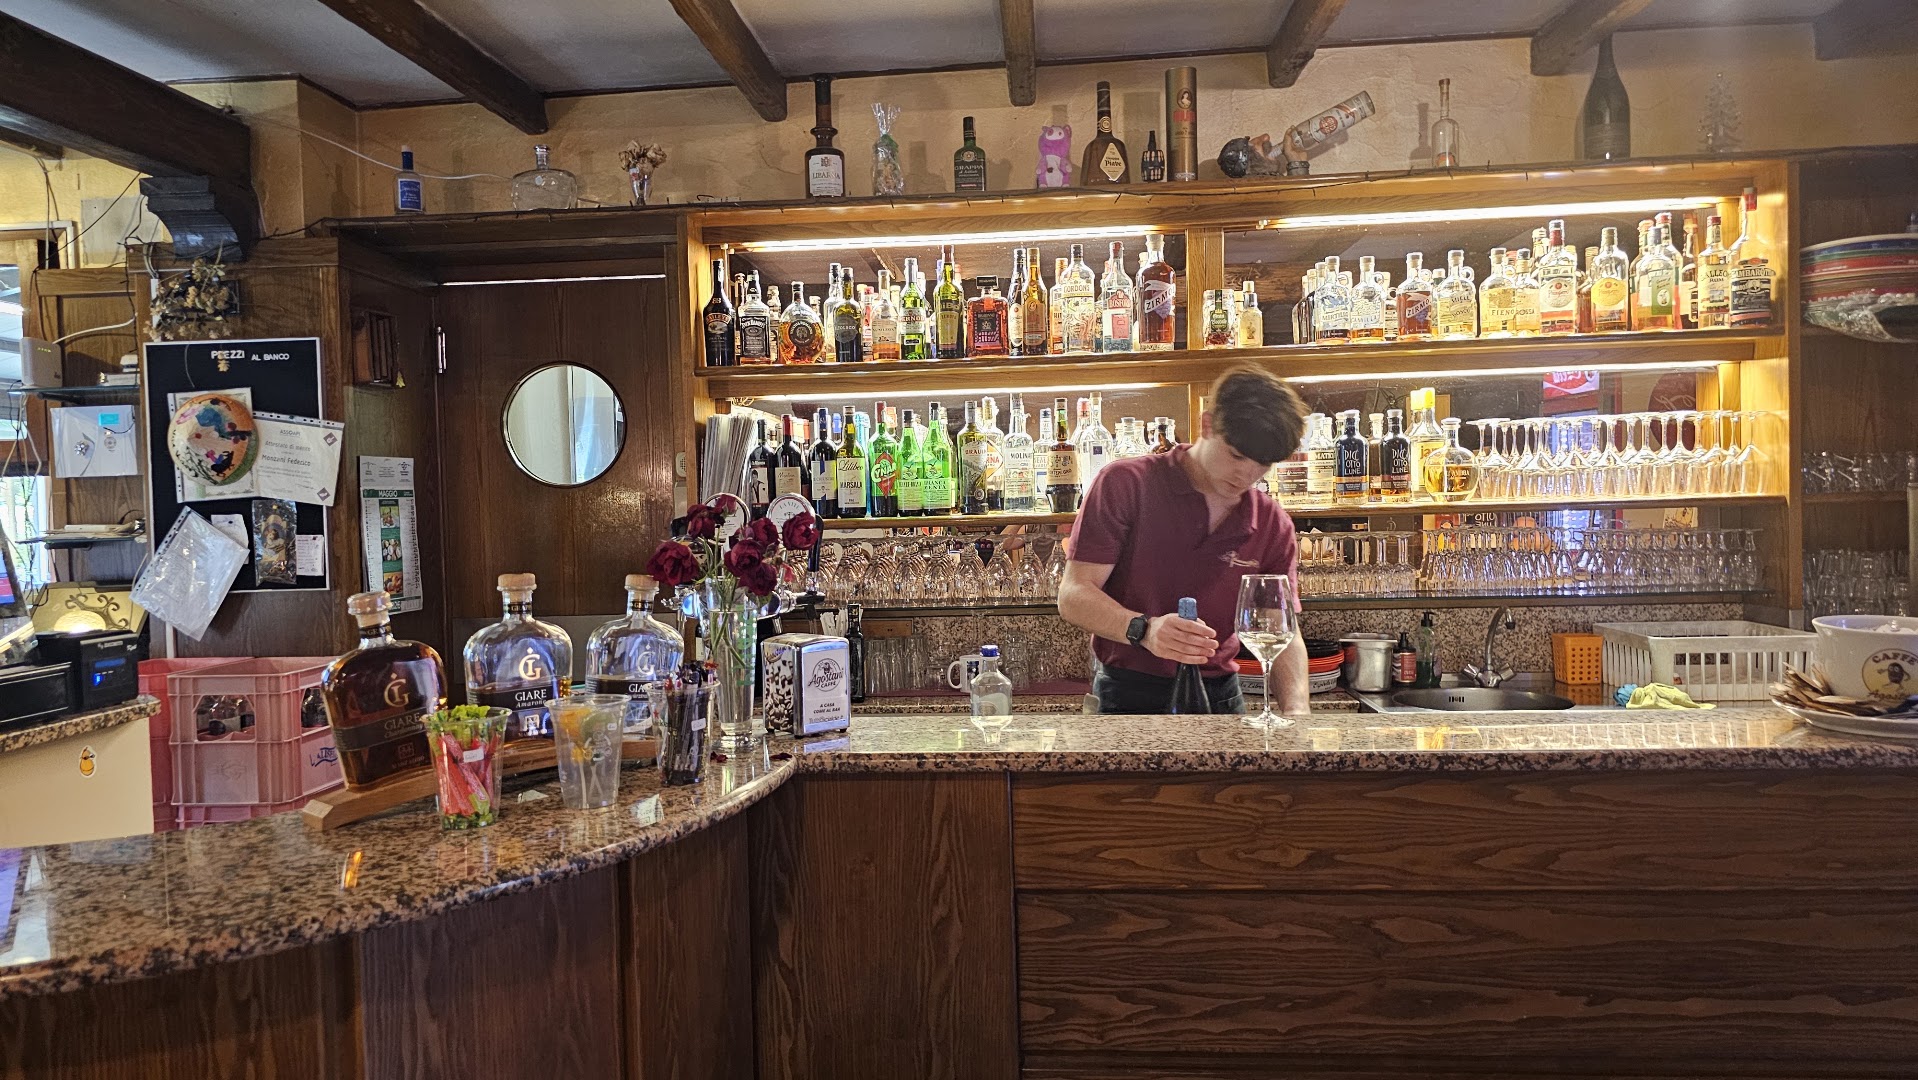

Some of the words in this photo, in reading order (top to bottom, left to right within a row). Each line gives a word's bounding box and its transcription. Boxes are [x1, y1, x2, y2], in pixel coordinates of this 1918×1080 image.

[263, 353, 290, 361] BANCO
[840, 481, 863, 489] MARSALA
[378, 490, 398, 498] MAGGIO
[515, 688, 548, 701] GIARE
